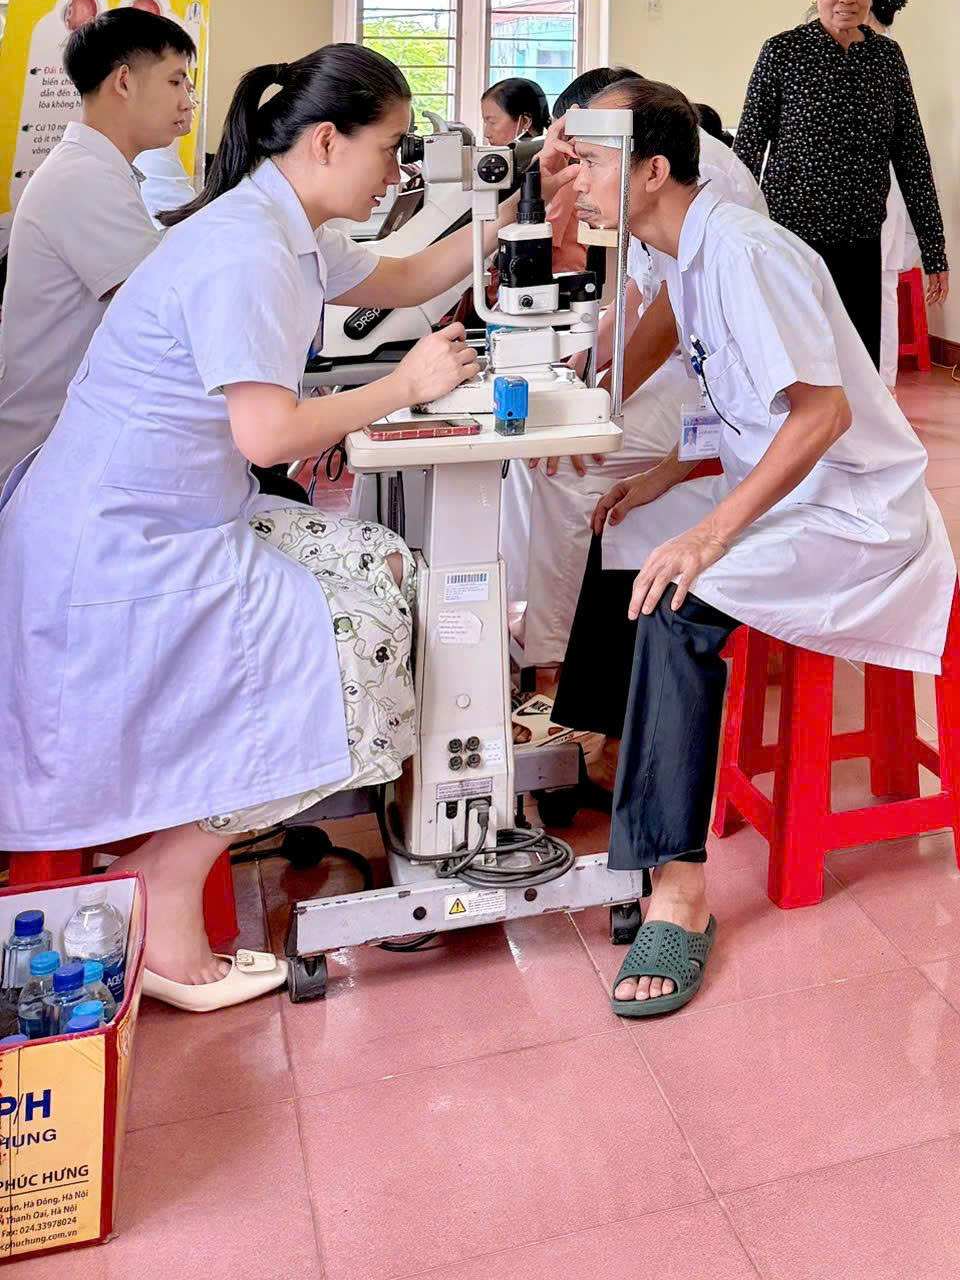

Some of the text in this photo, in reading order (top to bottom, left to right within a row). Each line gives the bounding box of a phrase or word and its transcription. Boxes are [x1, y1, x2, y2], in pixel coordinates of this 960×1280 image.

[42, 1164, 89, 1185] HƯNG
[74, 1189, 89, 1200] Nội
[63, 1204, 77, 1214] Nội
